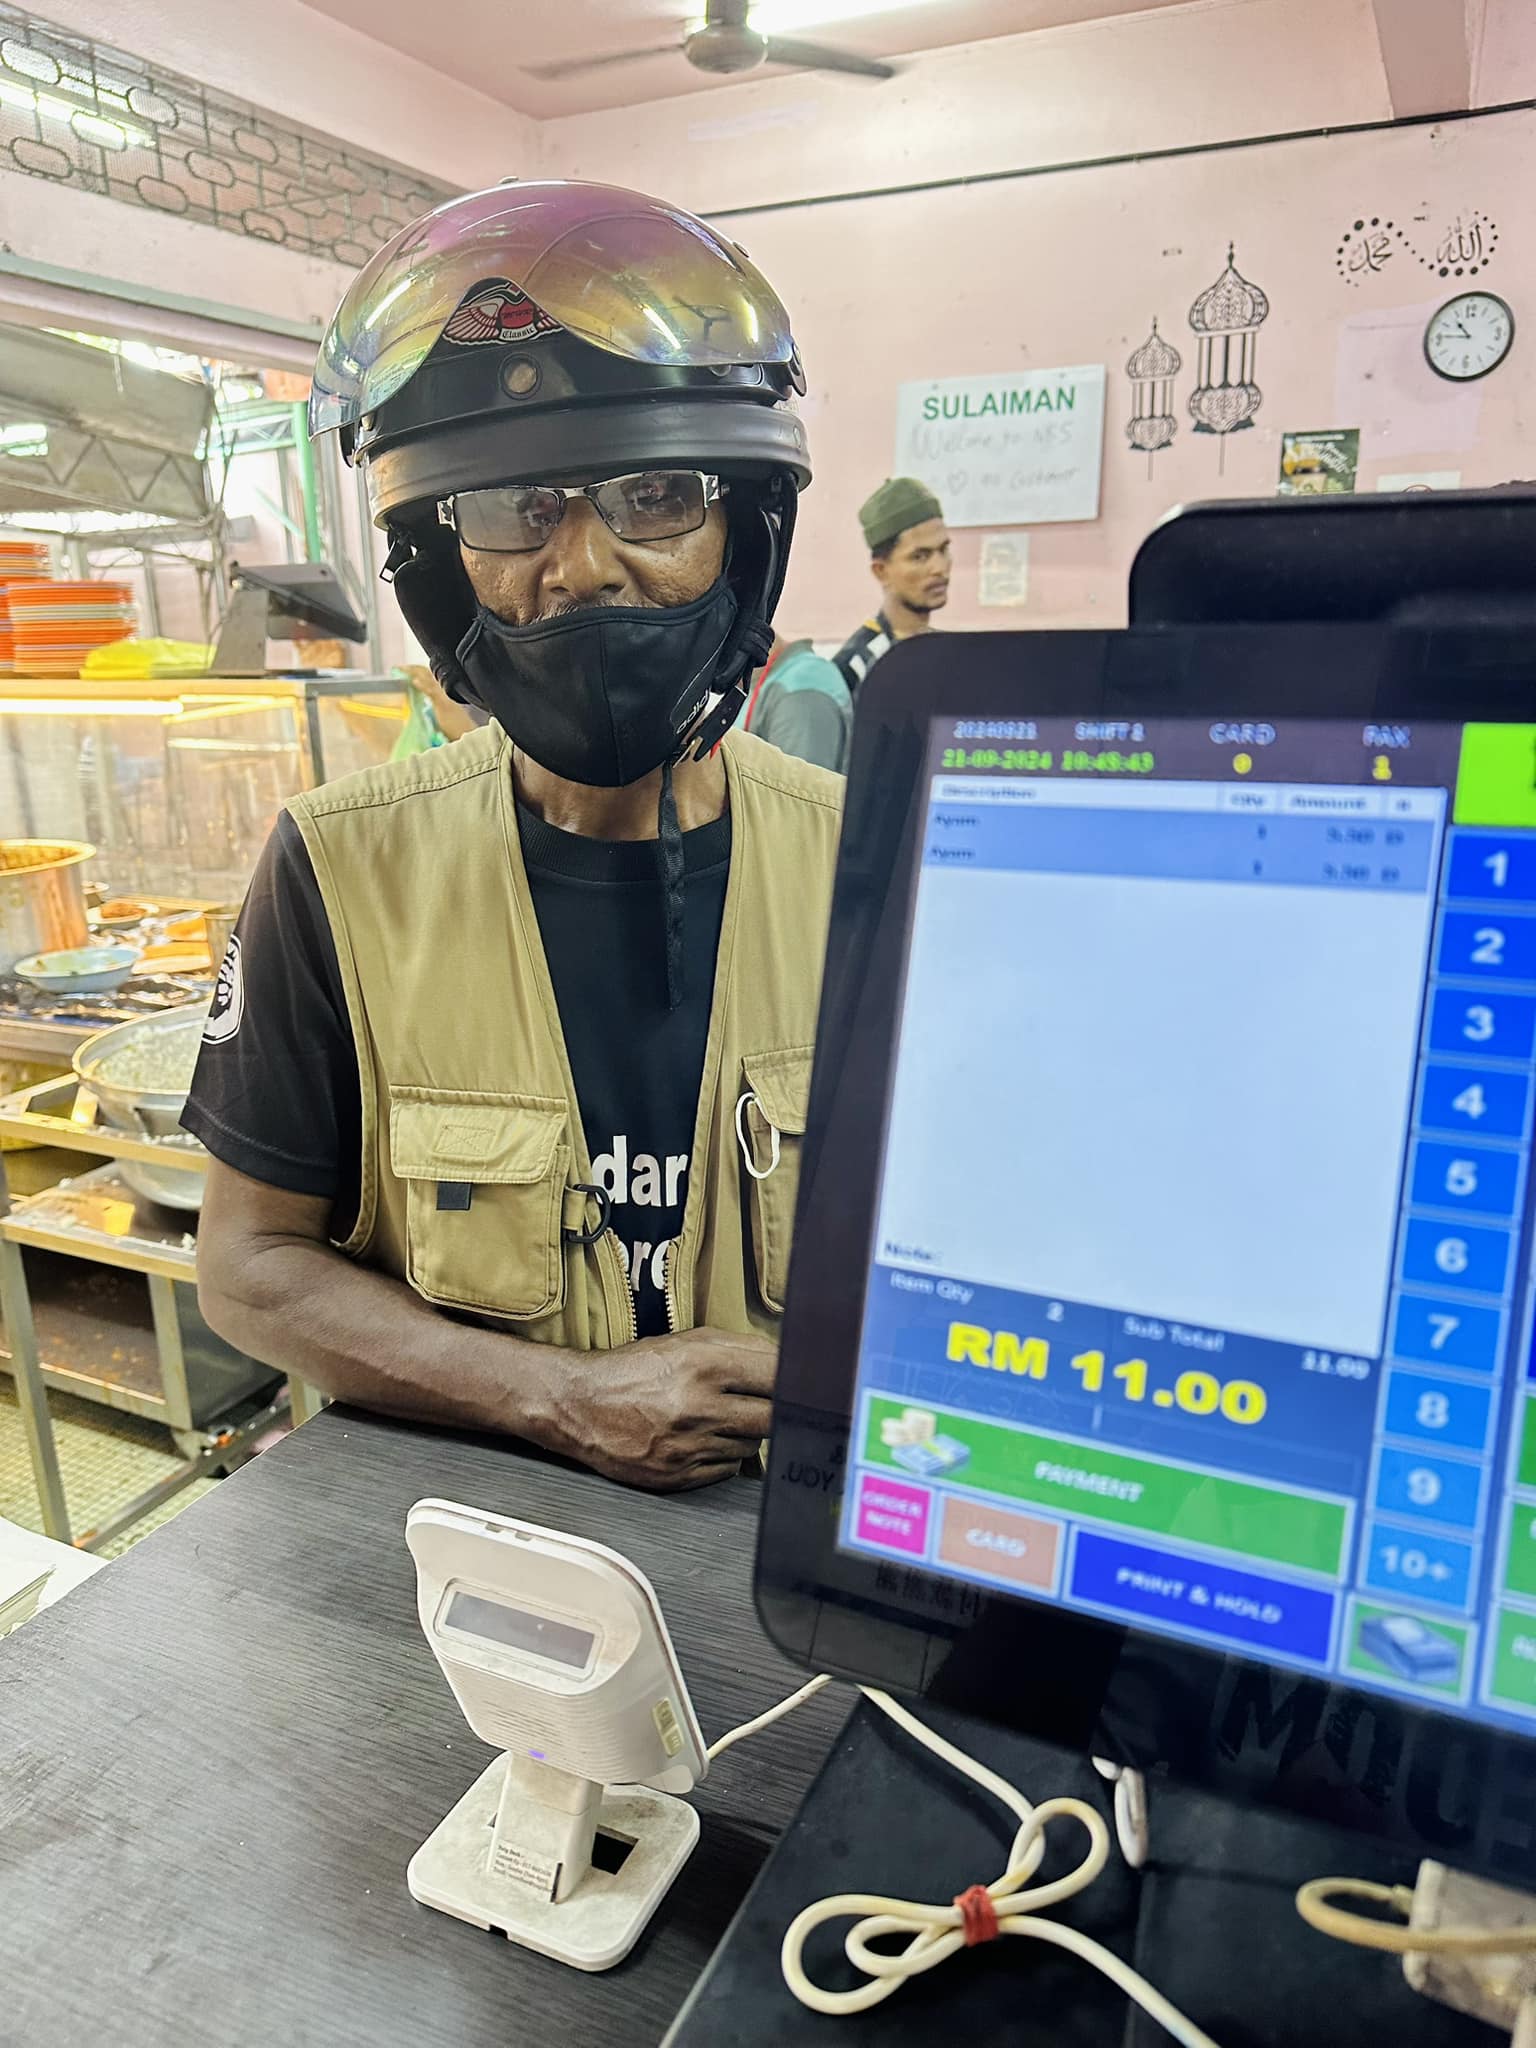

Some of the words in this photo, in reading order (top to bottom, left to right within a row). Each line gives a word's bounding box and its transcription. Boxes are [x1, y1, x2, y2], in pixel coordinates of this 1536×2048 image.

[922, 385, 1076, 421] SULAIMAN
[1209, 722, 1276, 746] CARD
[1363, 724, 1411, 748] PAX
[1484, 850, 1508, 888] 1
[1471, 927, 1505, 965] 2
[1463, 1004, 1495, 1041] 3
[1452, 1082, 1487, 1120] 4
[1446, 1158, 1478, 1196] 5
[1435, 1237, 1469, 1274] 6
[1123, 1315, 1166, 1341] Sub
[1170, 1323, 1226, 1352] Total
[1427, 1313, 1460, 1350] 7
[946, 1321, 1051, 1381] RM
[1070, 1349, 1268, 1425] 11.00
[1416, 1391, 1451, 1429] 8
[1034, 1460, 1144, 1503] PAYMENT
[1407, 1468, 1442, 1506] 9
[965, 1527, 1028, 1558] CARD
[1380, 1545, 1450, 1582] 10+
[1116, 1566, 1186, 1599] PRINT
[1213, 1591, 1284, 1625] HOLD
